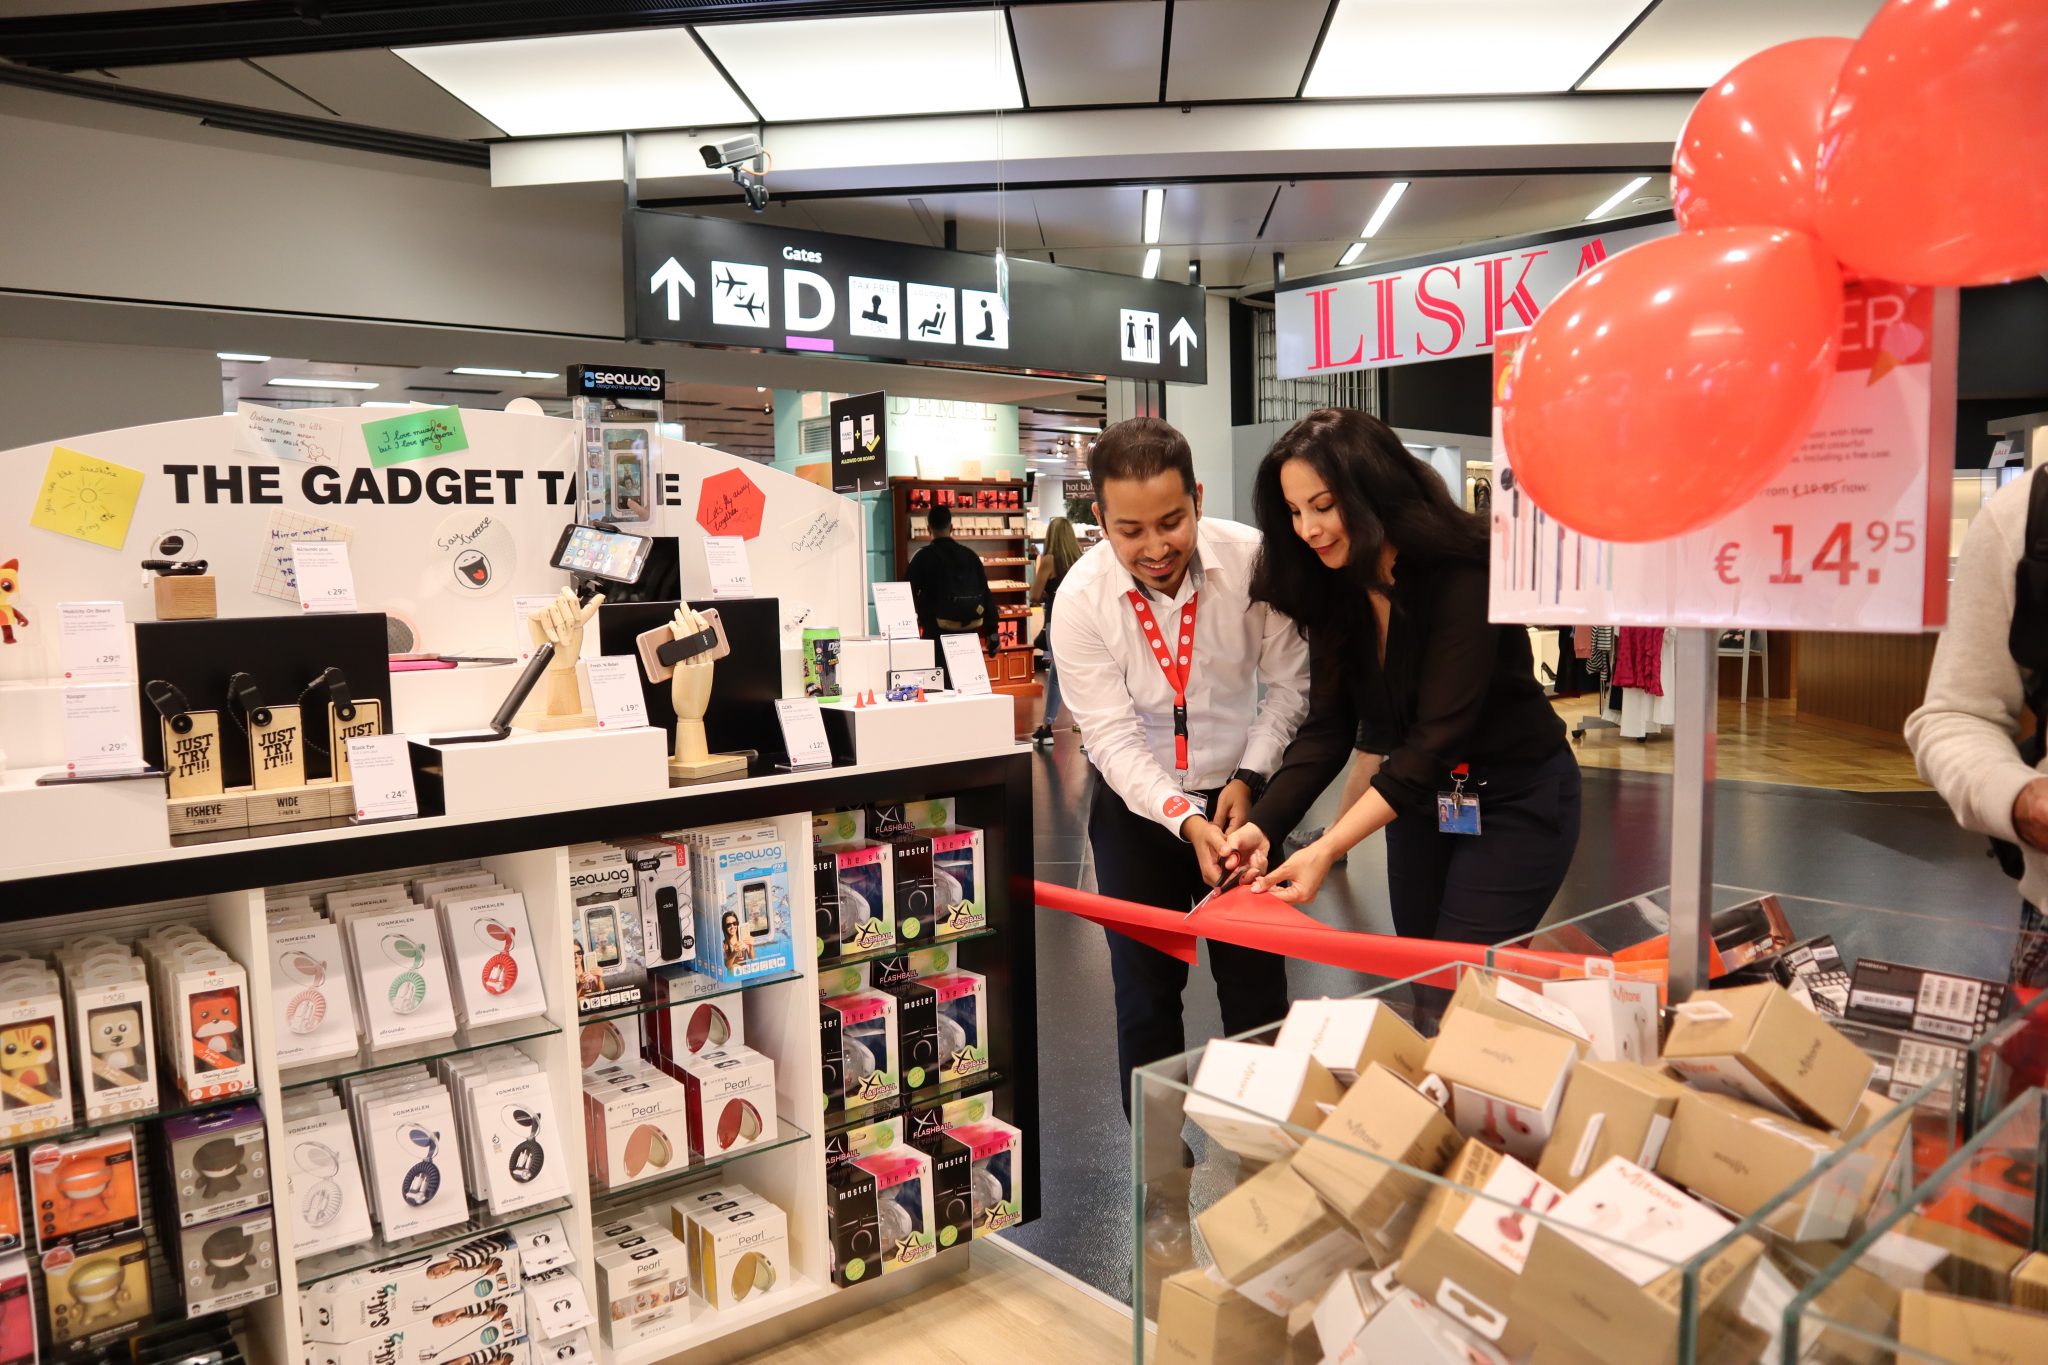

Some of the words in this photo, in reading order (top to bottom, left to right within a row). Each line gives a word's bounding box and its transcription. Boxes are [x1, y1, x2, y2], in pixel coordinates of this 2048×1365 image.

[782, 246, 823, 264] Gates
[784, 268, 836, 332] D
[595, 372, 661, 392] seawag
[394, 430, 412, 441] love
[378, 445, 392, 453] but
[163, 465, 283, 504] THE
[300, 465, 523, 505] GADGET
[538, 472, 682, 506] TAE
[1066, 482, 1078, 491] hot
[272, 530, 298, 539] Mirror
[303, 527, 329, 535] mirror
[437, 533, 464, 551] Say
[1714, 542, 1741, 585] €
[258, 727, 296, 747] JUST
[339, 721, 375, 741] JUST
[172, 733, 214, 754] JUST
[262, 740, 292, 757] TRY
[178, 747, 210, 765] TRY
[263, 752, 294, 770] IT!!!
[178, 760, 211, 778] IT!!!
[276, 797, 299, 808] WIDE
[185, 804, 223, 818] FISHEYE
[875, 821, 915, 834] FLASHBALL
[936, 840, 954, 851] the
[961, 836, 979, 847] sky
[728, 847, 782, 863] seawag
[841, 856, 860, 867] the
[868, 851, 888, 862] sky
[814, 859, 833, 871] ster
[570, 869, 630, 887] seawag
[950, 913, 985, 928] FLASHBALL
[856, 932, 894, 947] FLASHBALL
[879, 969, 919, 984] FLASHBALL
[694, 983, 720, 995] Pearl
[964, 983, 982, 994] sky
[872, 1007, 892, 1017] sky
[819, 1018, 838, 1030] ster
[953, 1057, 987, 1073] FLASHBALL
[724, 1077, 751, 1092] Pearl
[860, 1083, 897, 1099] FLASHBALL
[631, 1103, 661, 1118] Pearl
[913, 1121, 953, 1138] FLASHBALL
[999, 1138, 1017, 1151] sky
[825, 1149, 860, 1164] ASHBALL
[907, 1164, 928, 1178] sky
[985, 1211, 1020, 1230] FLASHBALL
[738, 1230, 765, 1246] Pearl
[898, 1242, 935, 1262] FLASHBALL
[637, 1260, 661, 1275] Pearl
